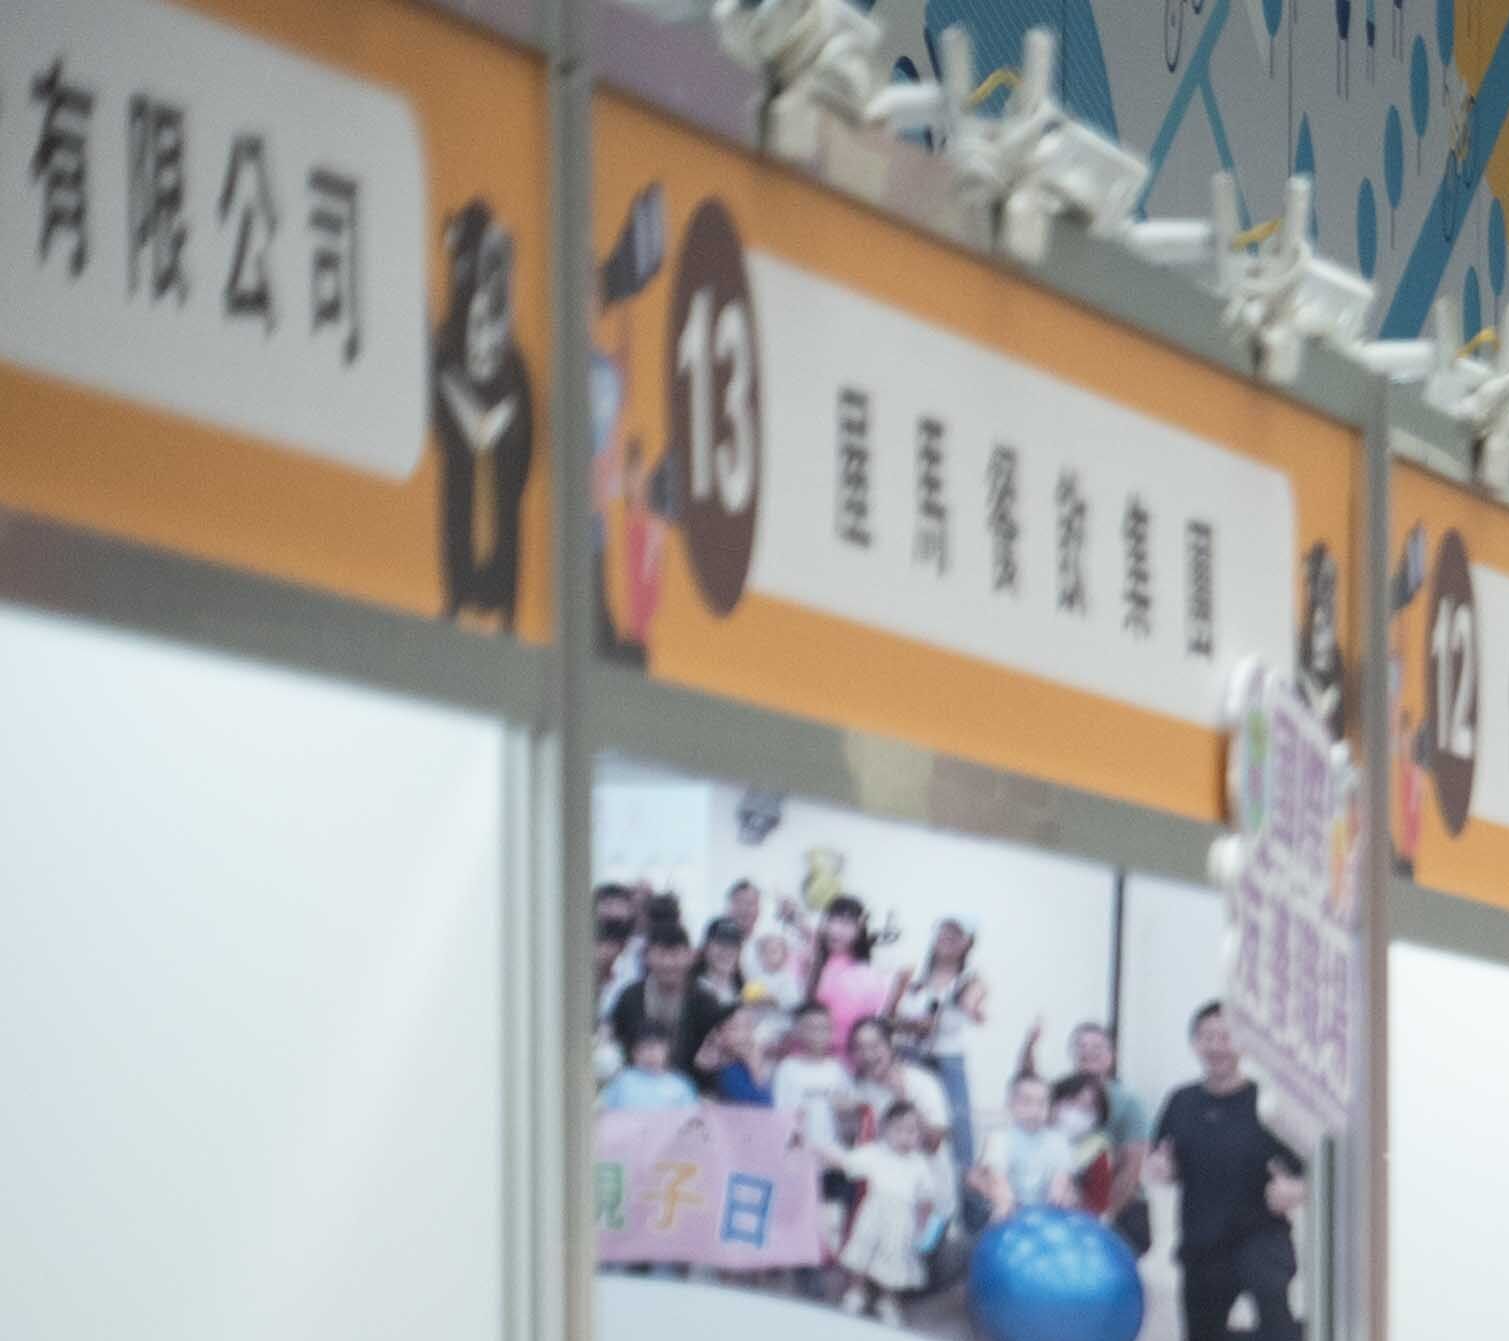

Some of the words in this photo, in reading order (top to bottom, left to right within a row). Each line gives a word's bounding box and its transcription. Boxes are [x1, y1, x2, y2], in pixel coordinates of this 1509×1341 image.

[30, 57, 364, 367] 有限公司
[676, 285, 755, 515] 13
[1431, 595, 1475, 760] 12
